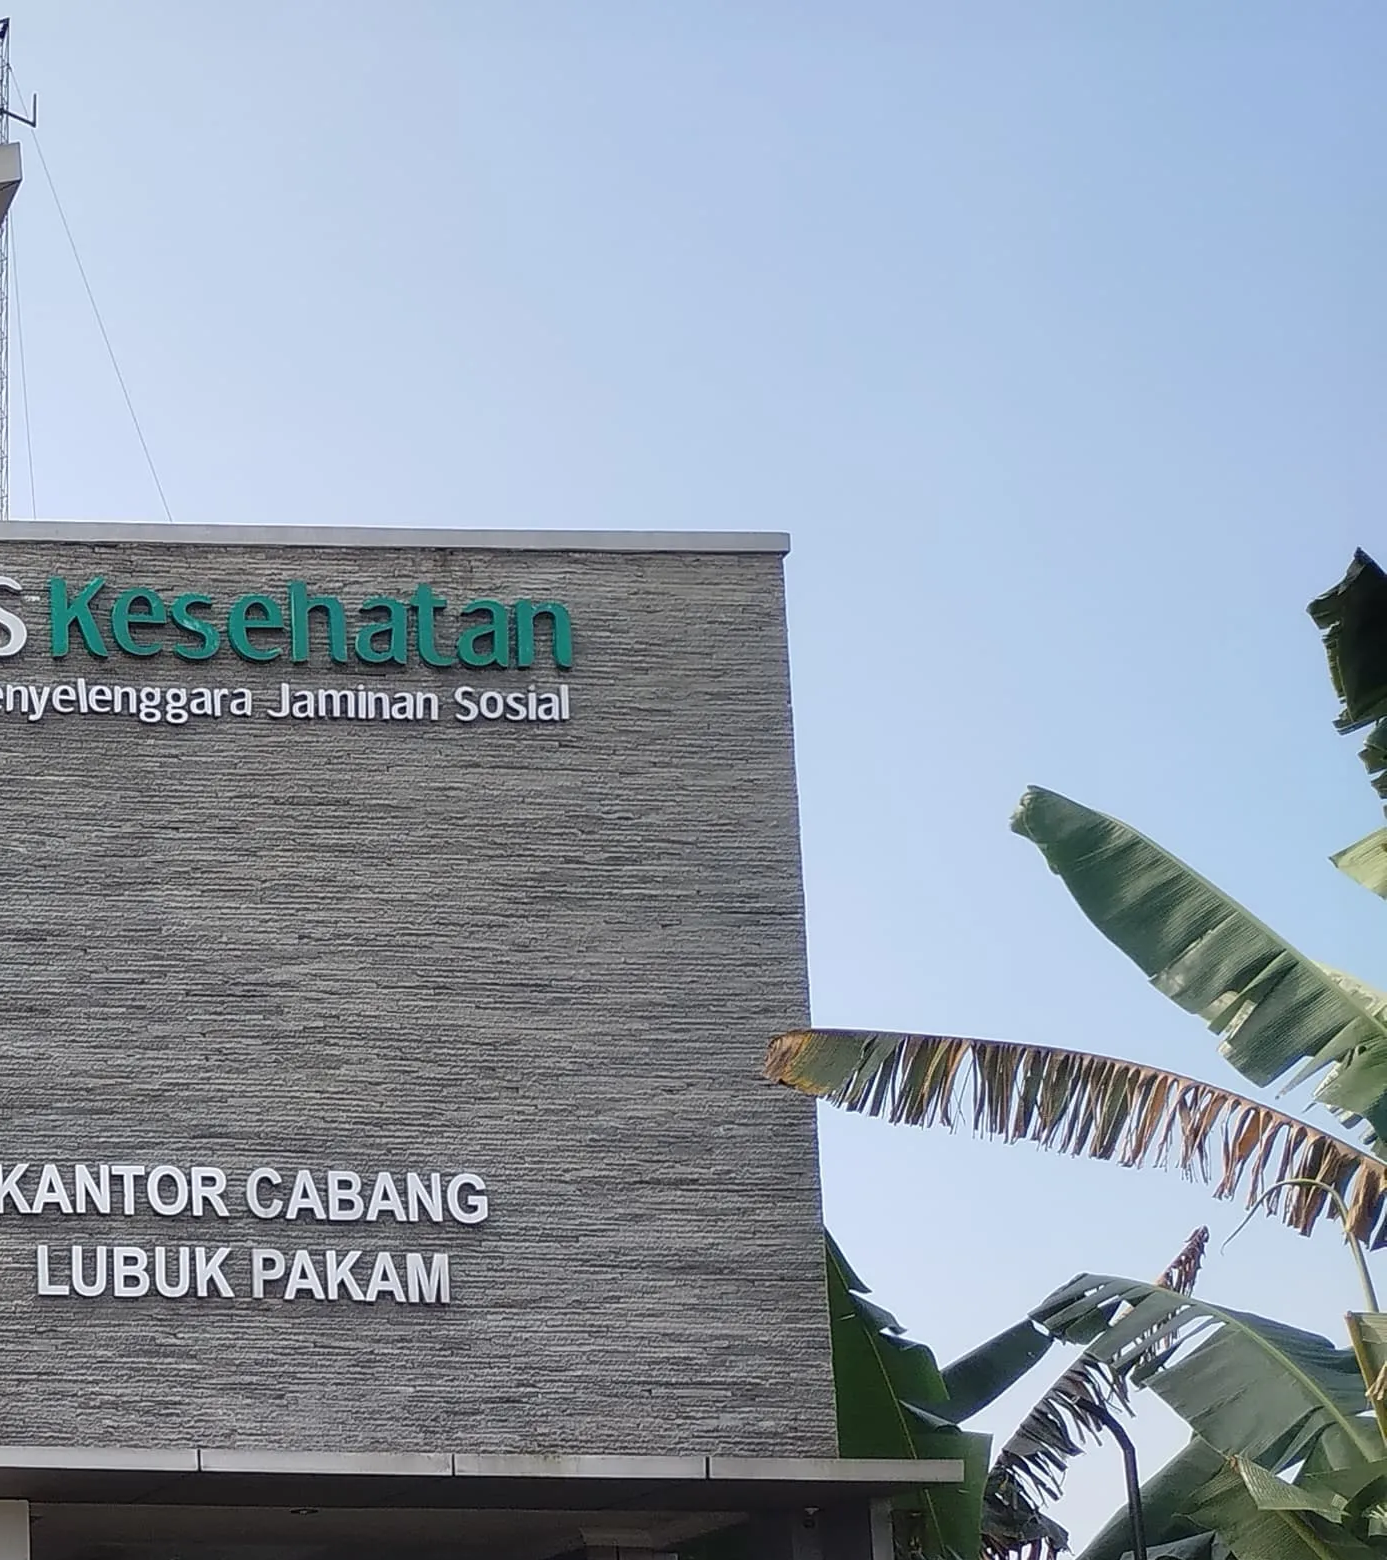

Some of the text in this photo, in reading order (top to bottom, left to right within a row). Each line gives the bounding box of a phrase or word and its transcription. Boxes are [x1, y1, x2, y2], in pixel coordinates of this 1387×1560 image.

[48, 574, 574, 669] Kesehatan
[267, 682, 439, 721] Jaminan
[453, 683, 570, 722] Sosial
[245, 1167, 489, 1224] CABANG
[36, 1244, 451, 1304] LUBUK PAKAM
